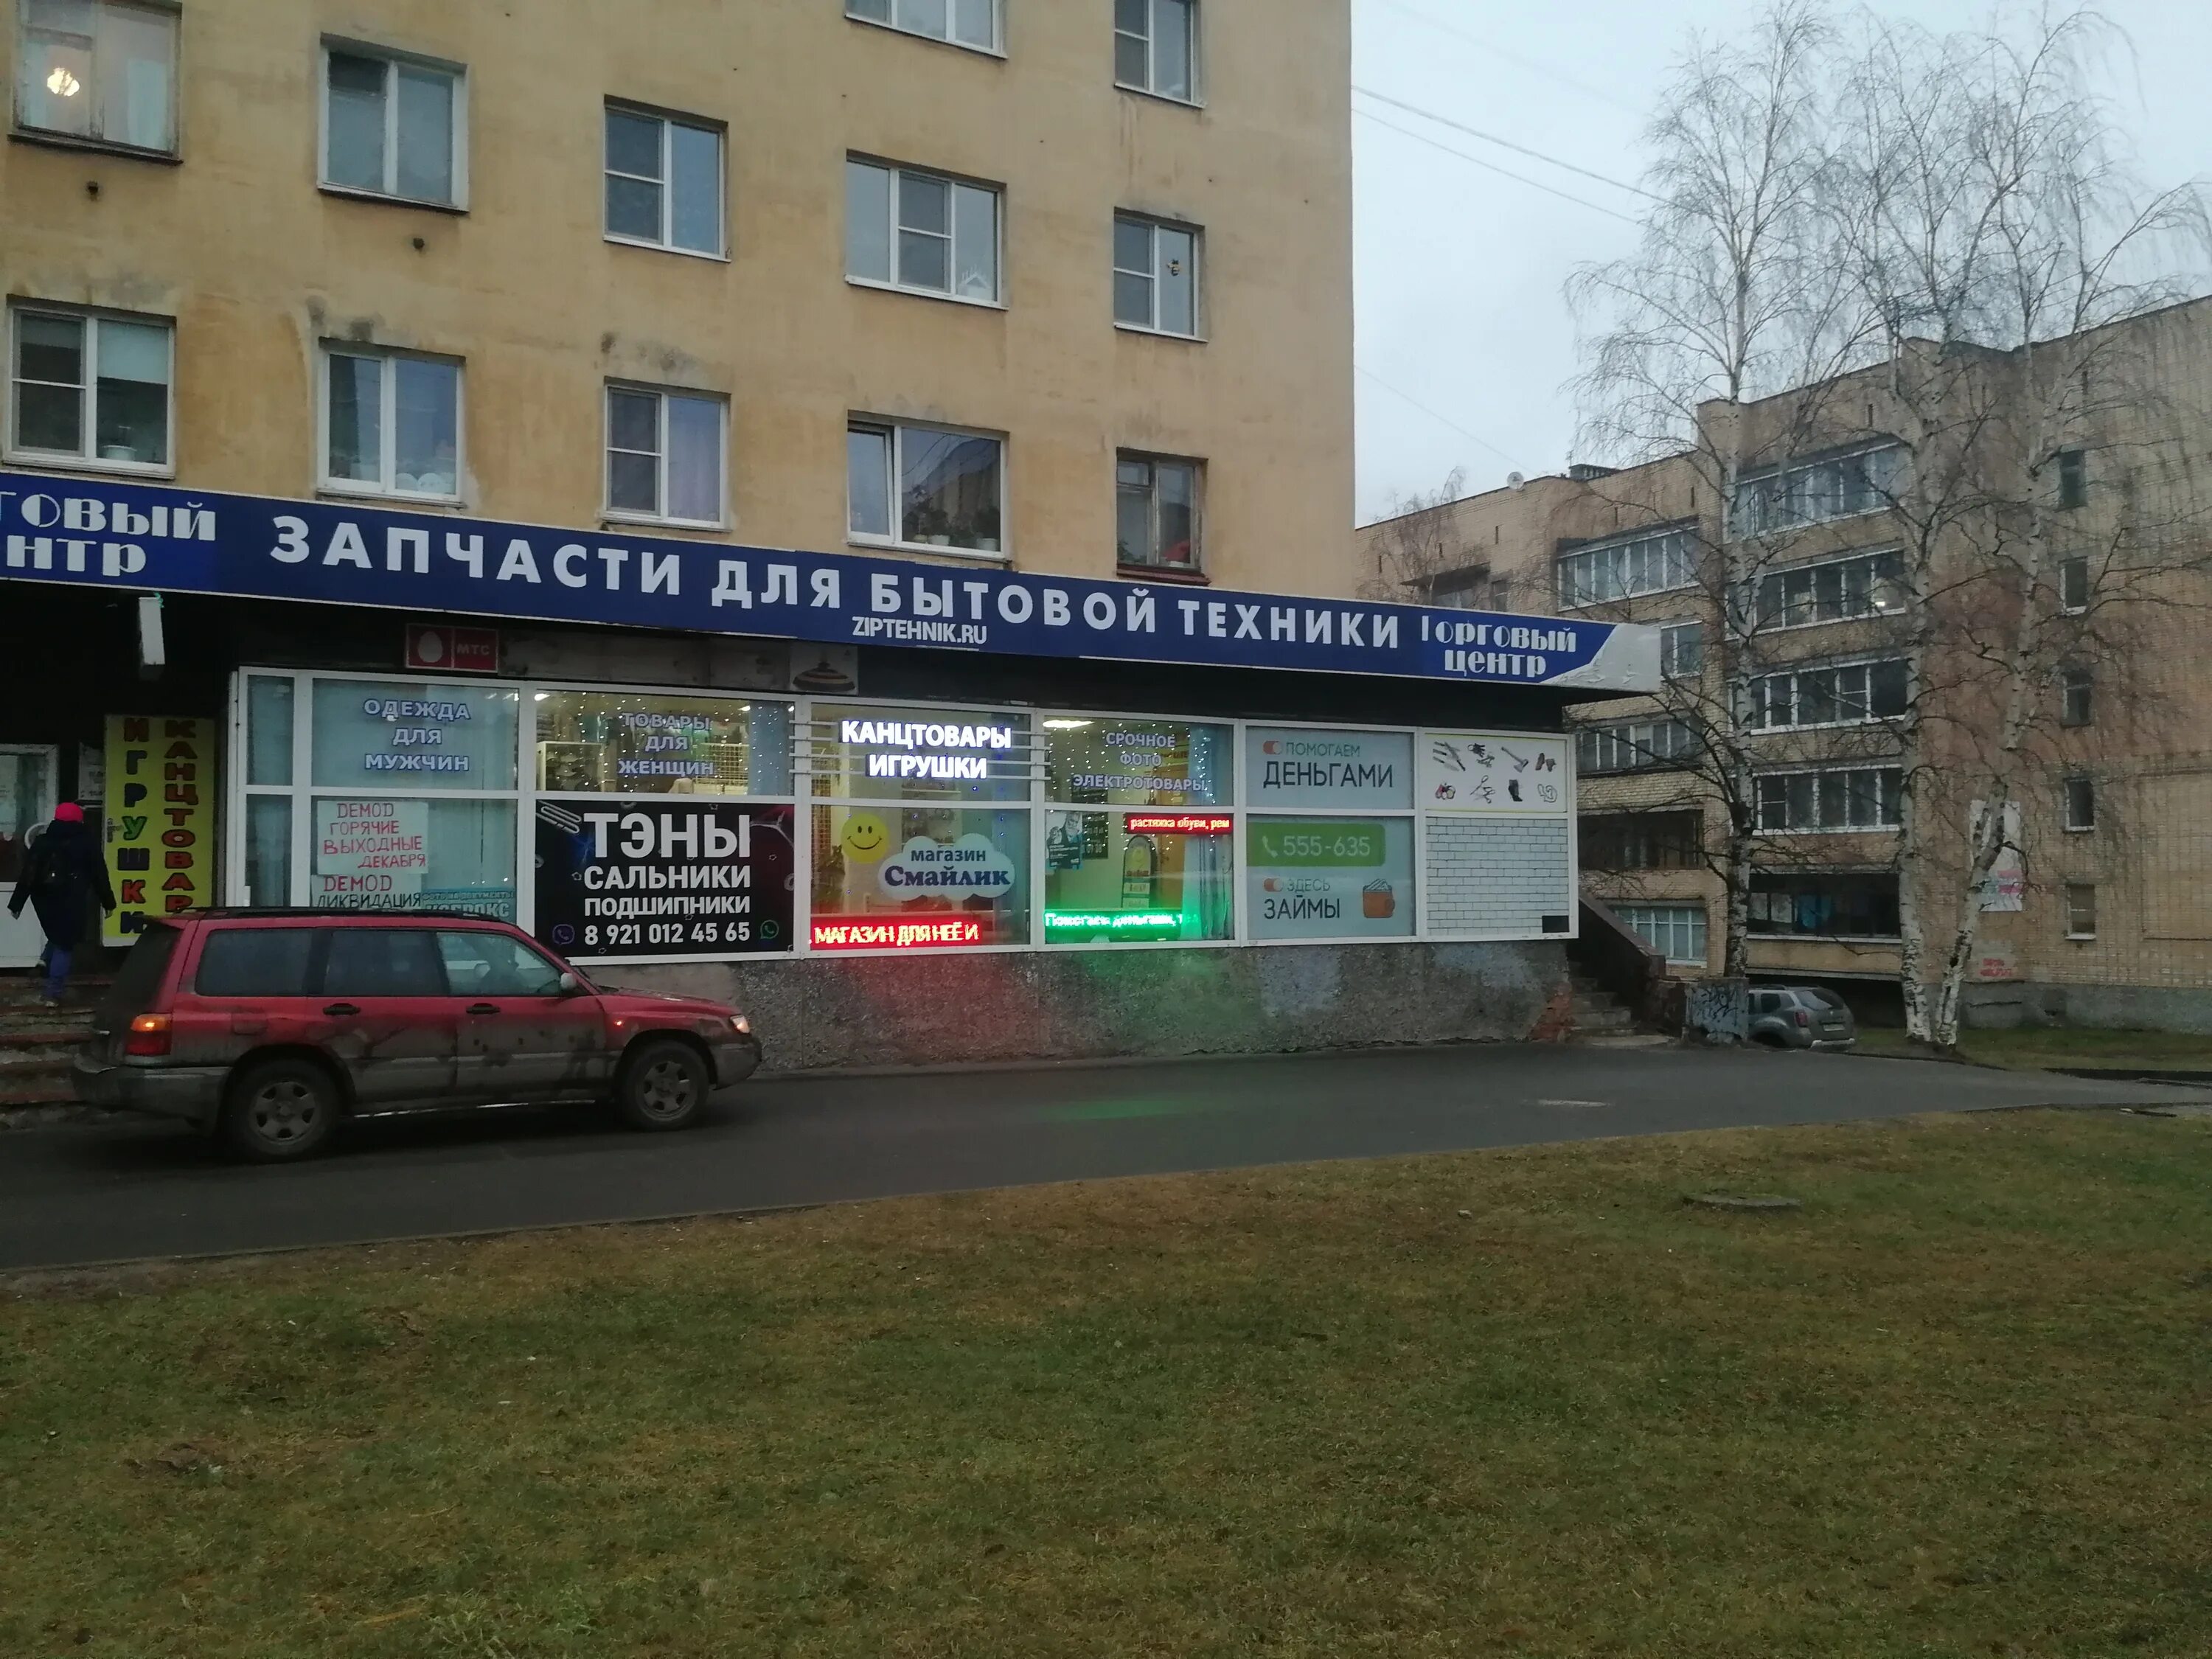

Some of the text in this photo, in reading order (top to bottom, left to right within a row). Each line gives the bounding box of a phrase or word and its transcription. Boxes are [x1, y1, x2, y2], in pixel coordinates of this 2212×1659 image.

[270, 515, 1399, 649] ЗАПЧАСТИ ДЛЯ БЫТОВОЙ ТЕХНИКИ
[852, 616, 988, 645] ZIPTEHNIK.RU
[456, 643, 490, 655] МТС
[364, 699, 471, 721] ОДЕЖДА
[622, 712, 710, 731] ТОВАРЫ
[392, 728, 442, 746] ДЛЯ
[644, 735, 689, 752] ДЛЯ
[841, 720, 1012, 750] КАНЦТОВАРЫ
[1106, 732, 1176, 748] СРОЧНОЕ
[1286, 742, 1360, 757] ПОМОГАЕМ
[365, 754, 470, 771] МУЖЧИН
[619, 761, 714, 776] ЖЕНЩИН
[868, 754, 987, 779] ИГРУШКИ
[1119, 754, 1163, 767] ФОТО
[1073, 774, 1206, 791] ЭЛЕКТРОТОВАРЫ
[1263, 761, 1394, 789] ДЕНЬГАМИ
[161, 720, 198, 914] КАНЦТОВАР
[337, 803, 394, 818] DEMOD
[330, 821, 400, 835] ГОРЯЧИЕ
[583, 813, 751, 858] ТЭНЫ
[324, 836, 422, 855] ВЫХОДНЫЕ
[1283, 835, 1371, 857] 555-635
[358, 853, 426, 869] ДЕКАБРЯ
[911, 849, 987, 862] магазин
[324, 874, 392, 892] DEMOD
[584, 865, 751, 889] САЛЬНИКИ
[885, 865, 1011, 887] Смайлик
[1287, 878, 1331, 893] ЗДЕСЬ
[317, 892, 421, 908] ЛИКВИДАЦИЯ
[584, 896, 751, 919] ПОДШИПНИКИ
[1263, 894, 1340, 919] ЗАЙМЫ
[585, 922, 751, 945] 8 921 012 45 65
[814, 925, 895, 945] МАГАЗИН
